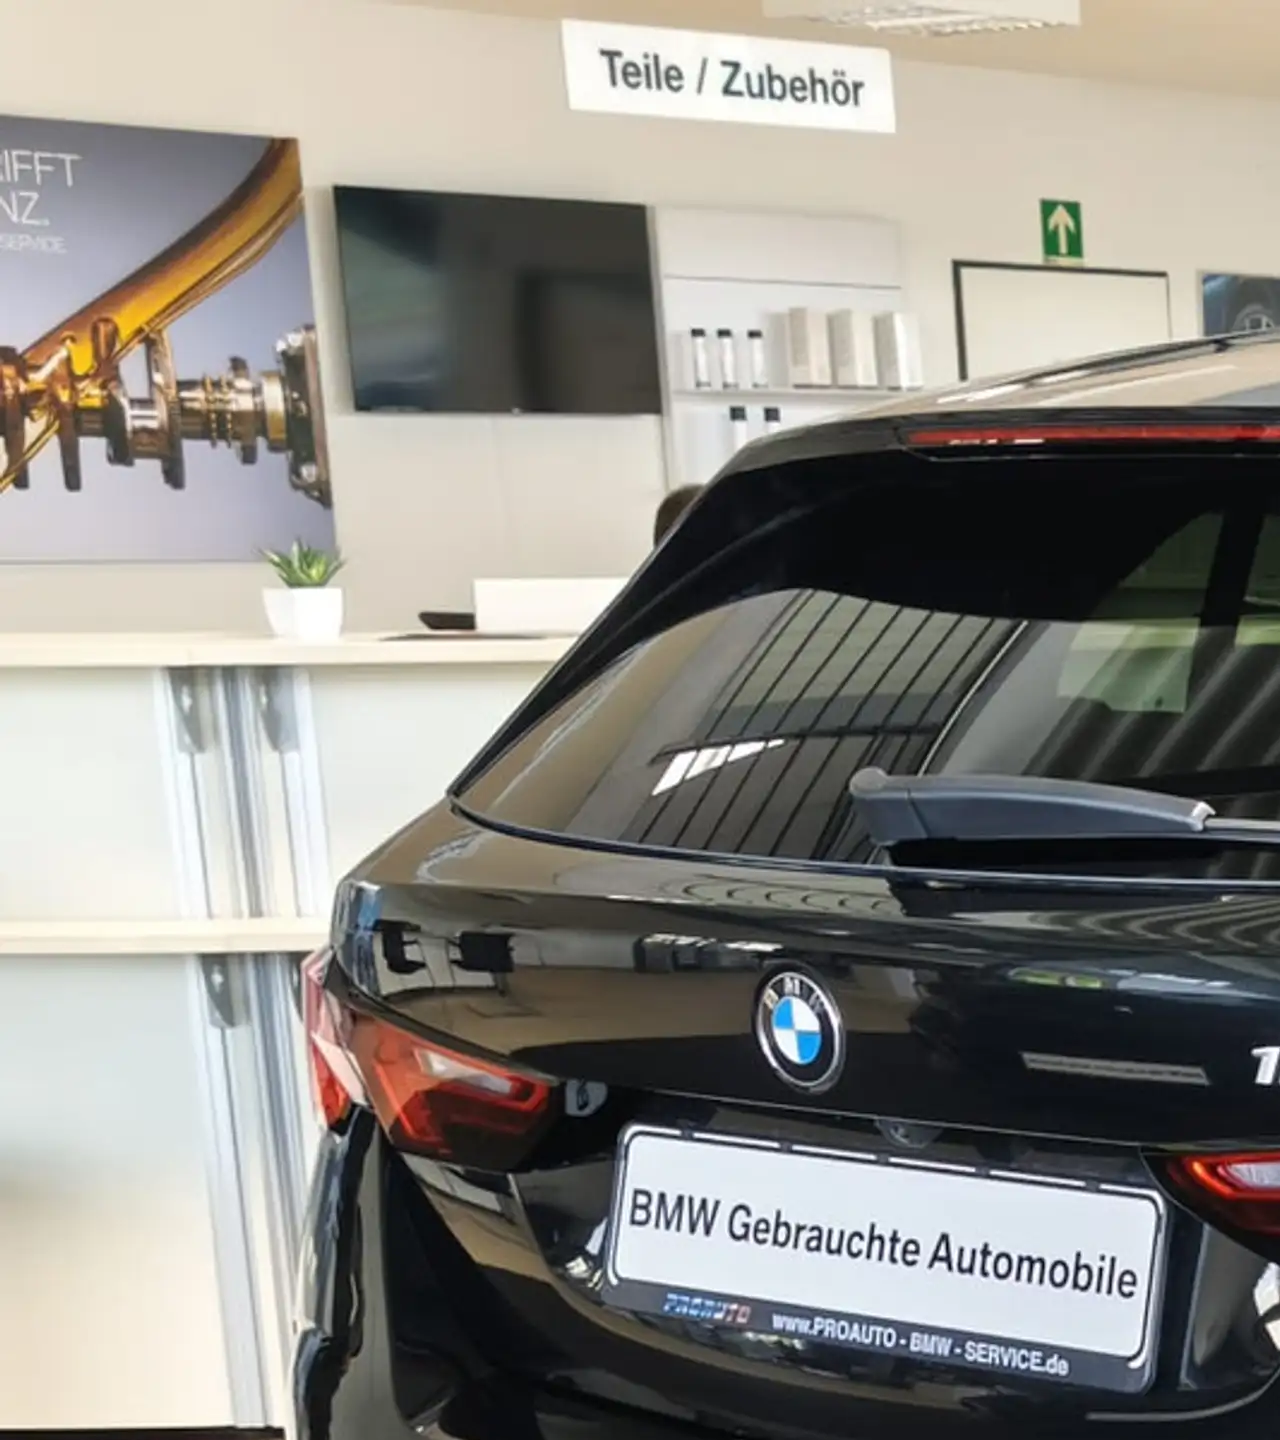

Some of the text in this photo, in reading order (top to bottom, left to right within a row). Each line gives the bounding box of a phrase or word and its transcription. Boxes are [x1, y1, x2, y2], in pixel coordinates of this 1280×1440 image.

[599, 49, 865, 107] Teile / Zubehör
[0, 149, 84, 188] IFFT
[628, 1187, 1139, 1300] BMW Gebrauchte Automobile
[909, 1331, 954, 1358] BMW
[964, 1340, 1070, 1377] SERVICE.de
